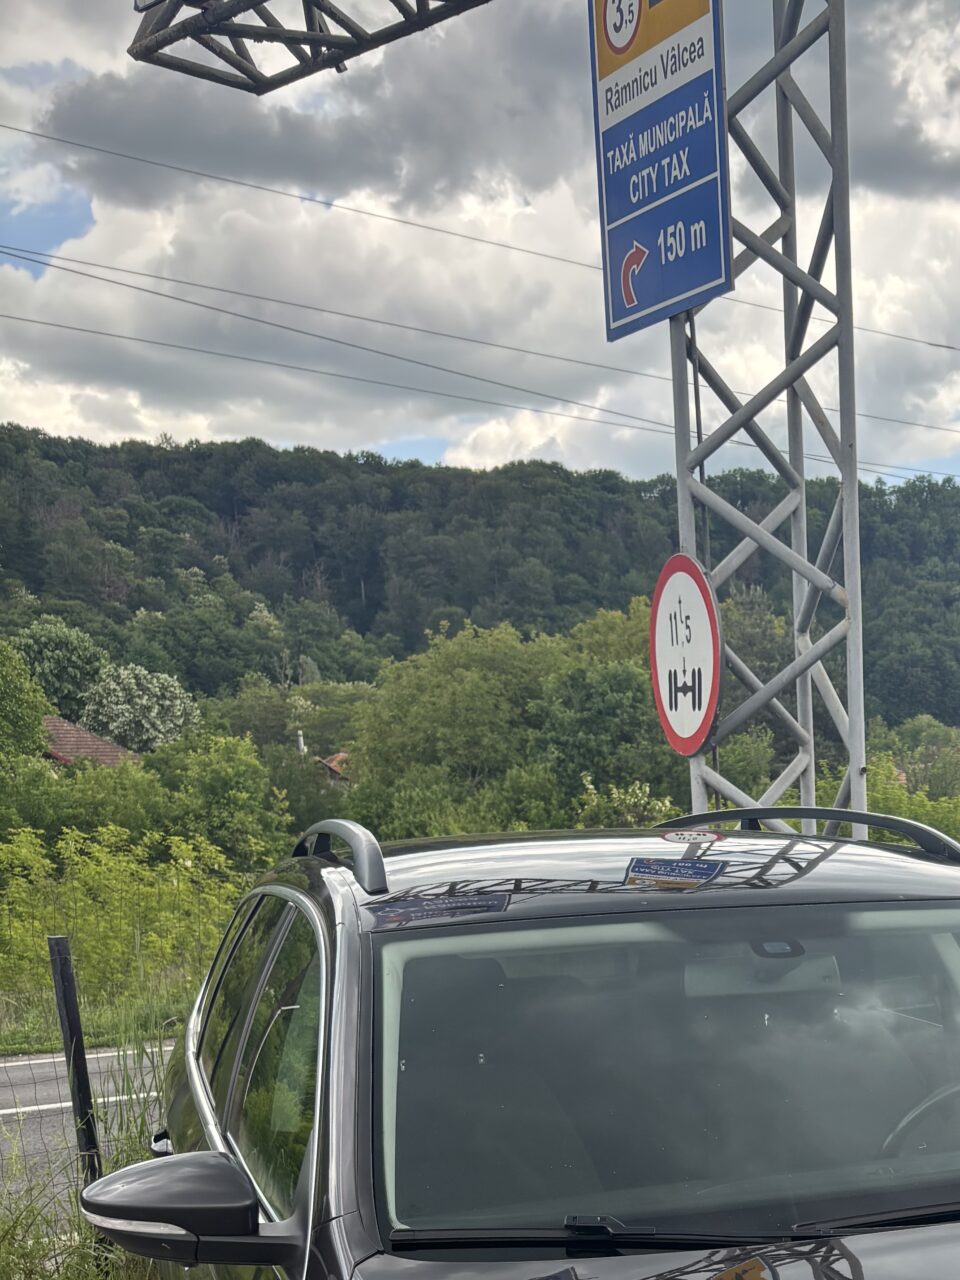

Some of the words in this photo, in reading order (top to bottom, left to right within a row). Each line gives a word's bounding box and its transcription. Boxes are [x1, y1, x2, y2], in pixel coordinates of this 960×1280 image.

[605, 64, 658, 116] Râmnicu
[660, 36, 705, 80] Vâlcea
[607, 133, 636, 175] TAXĂ
[638, 91, 712, 155] MUNICIPALĂ
[629, 162, 659, 204] CITY
[661, 147, 691, 185] TAX
[657, 220, 686, 265] 150
[690, 220, 706, 250] m
